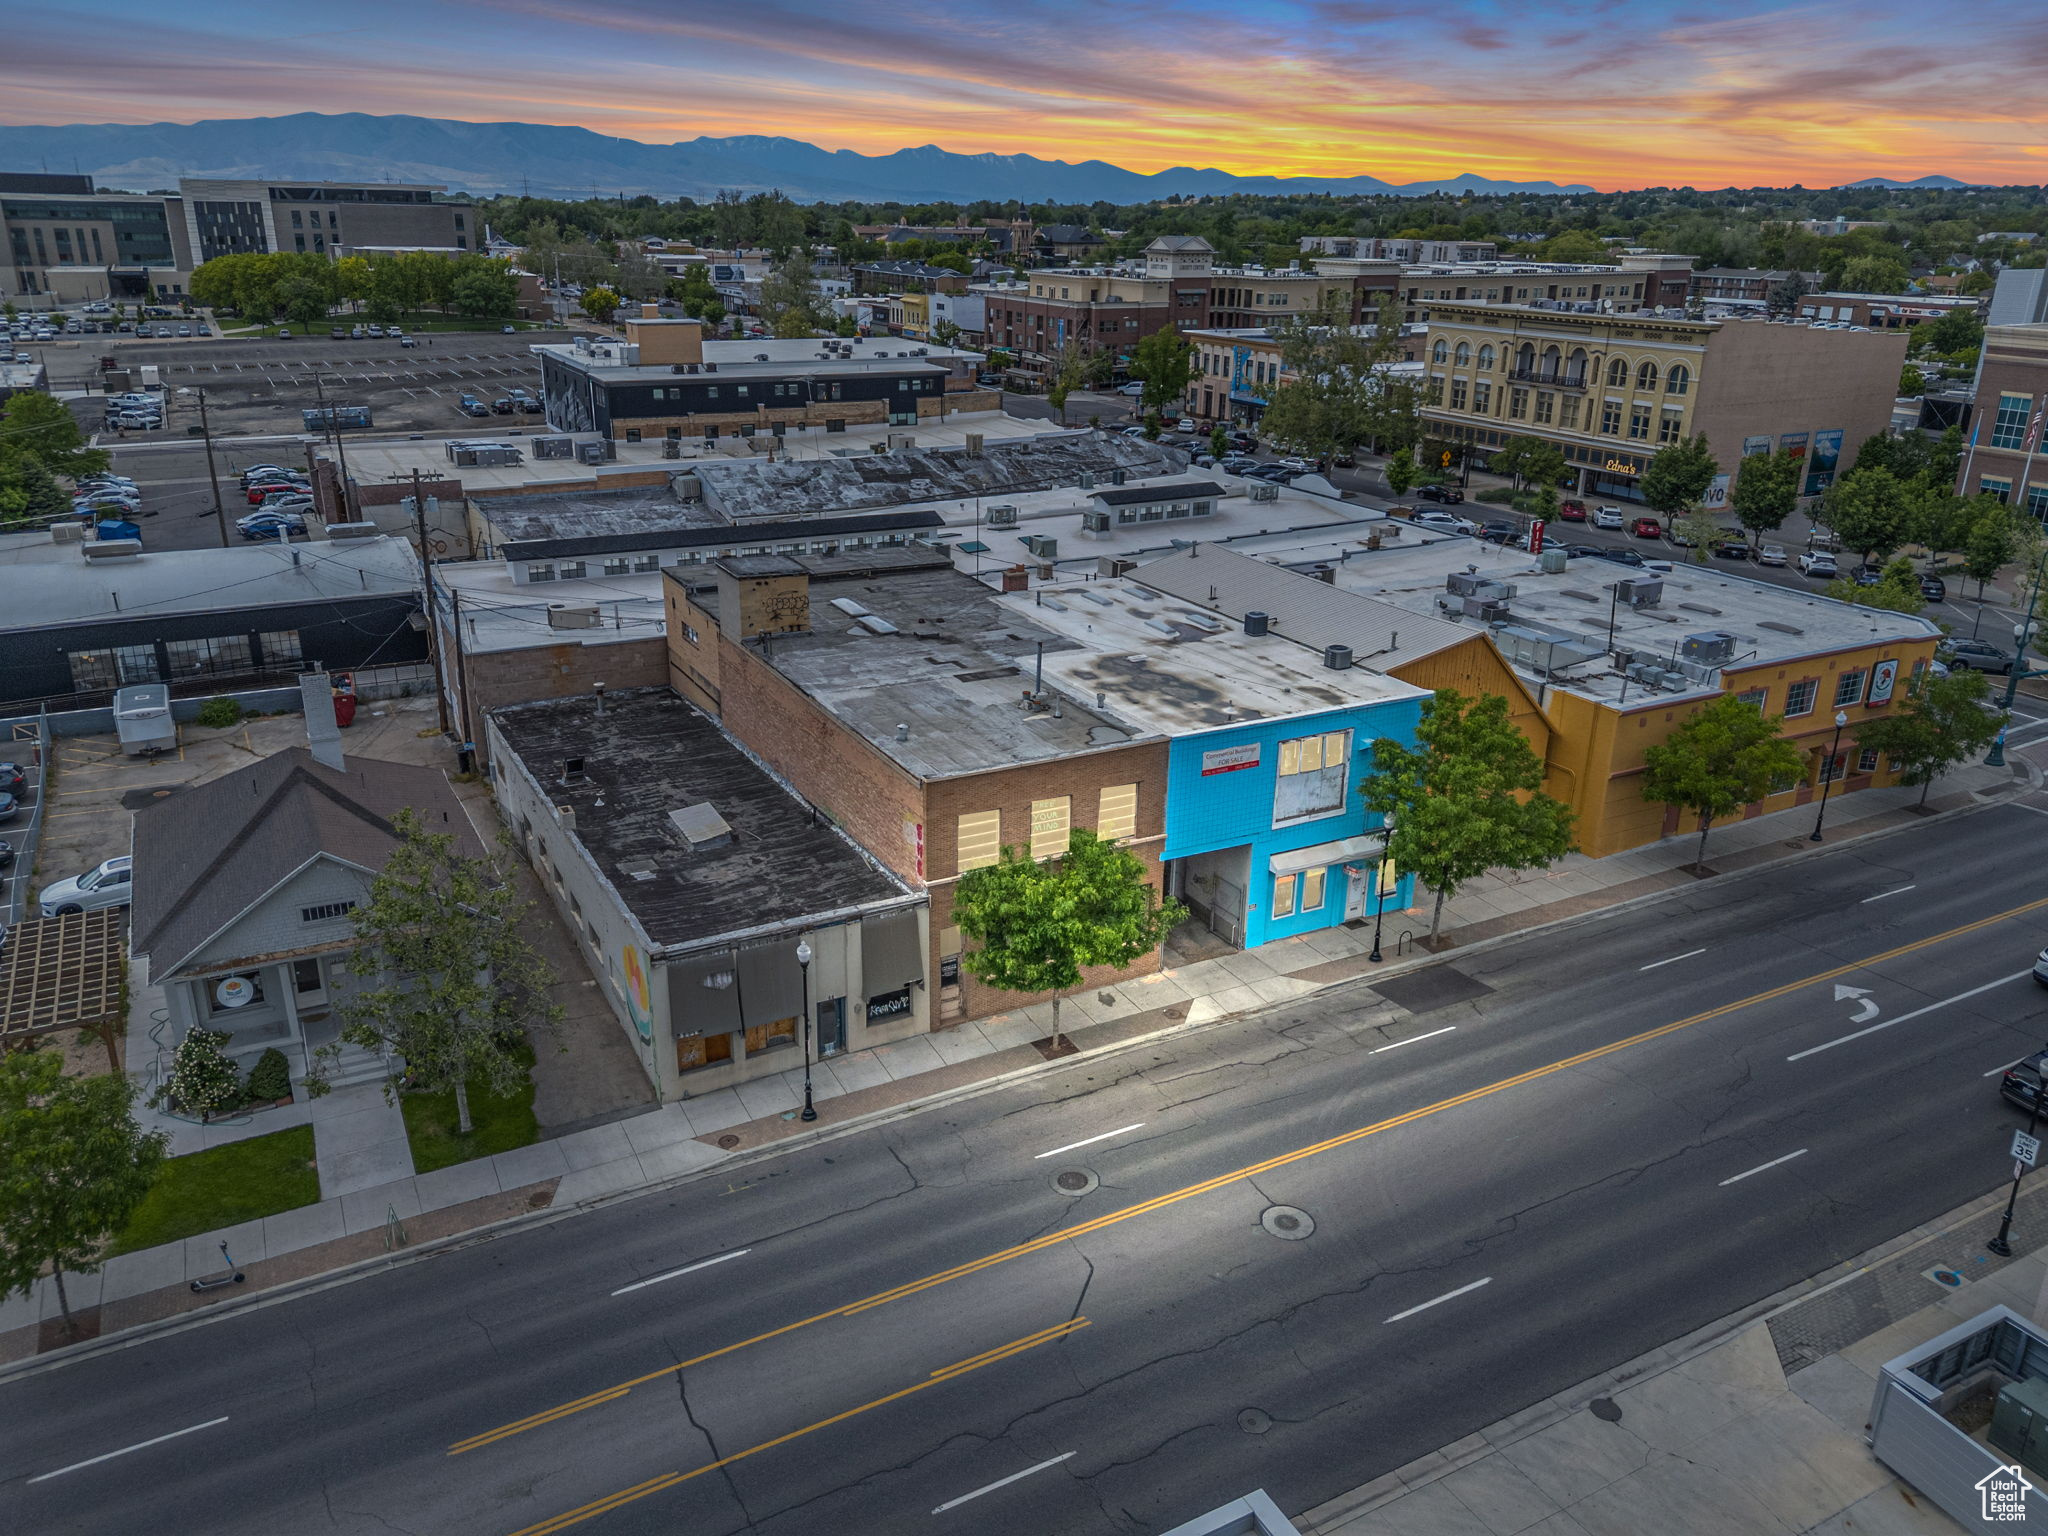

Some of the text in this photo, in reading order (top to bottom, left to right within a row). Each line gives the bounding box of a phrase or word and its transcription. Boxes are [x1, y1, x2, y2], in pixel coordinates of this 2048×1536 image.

[1606, 459, 1636, 475] Edna's
[1205, 746, 1257, 760] Commercial Buildings
[1218, 756, 1244, 766] FOR SALE
[2018, 1132, 2037, 1146] SPEED
[2019, 1140, 2033, 1150] LIMIT
[2014, 1144, 2034, 1161] 35
